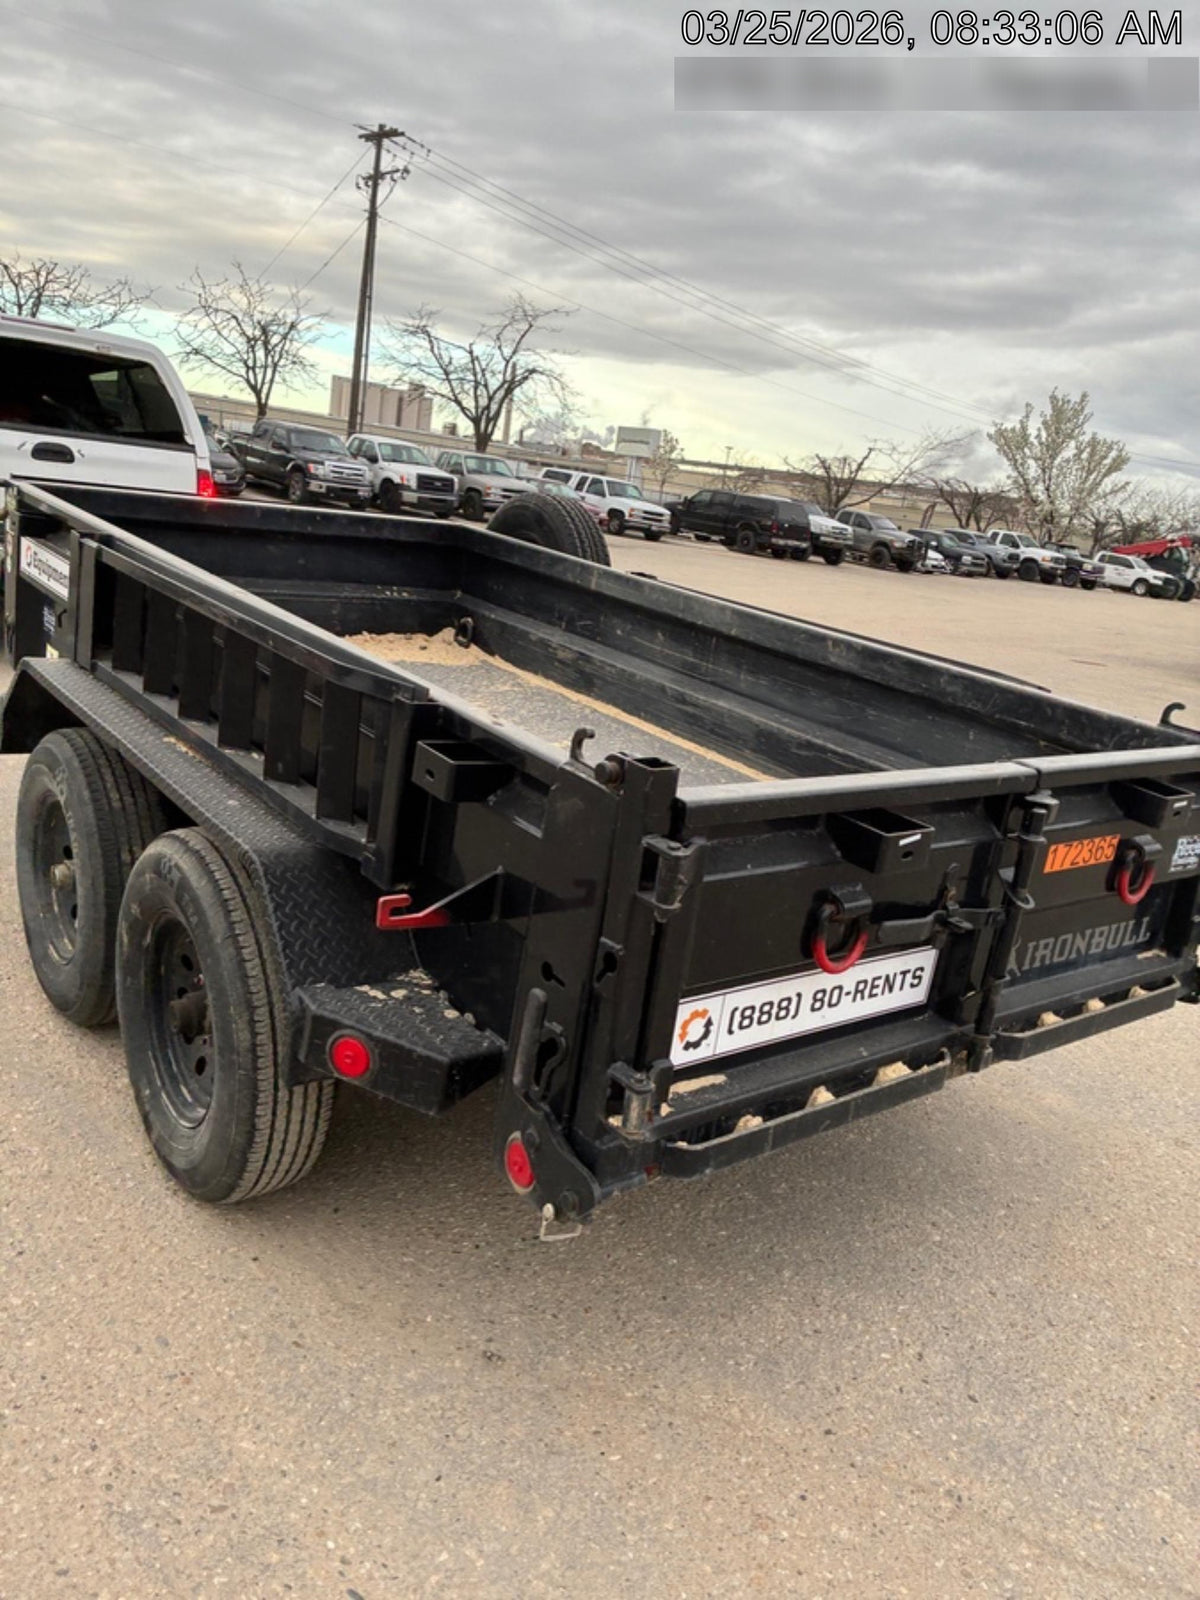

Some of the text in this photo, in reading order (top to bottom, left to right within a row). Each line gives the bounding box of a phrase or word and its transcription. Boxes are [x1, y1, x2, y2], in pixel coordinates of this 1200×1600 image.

[1049, 836, 1118, 871] 172365
[1020, 917, 1152, 971] IRONBULL
[727, 966, 925, 1035] (888) 80-RENTS
